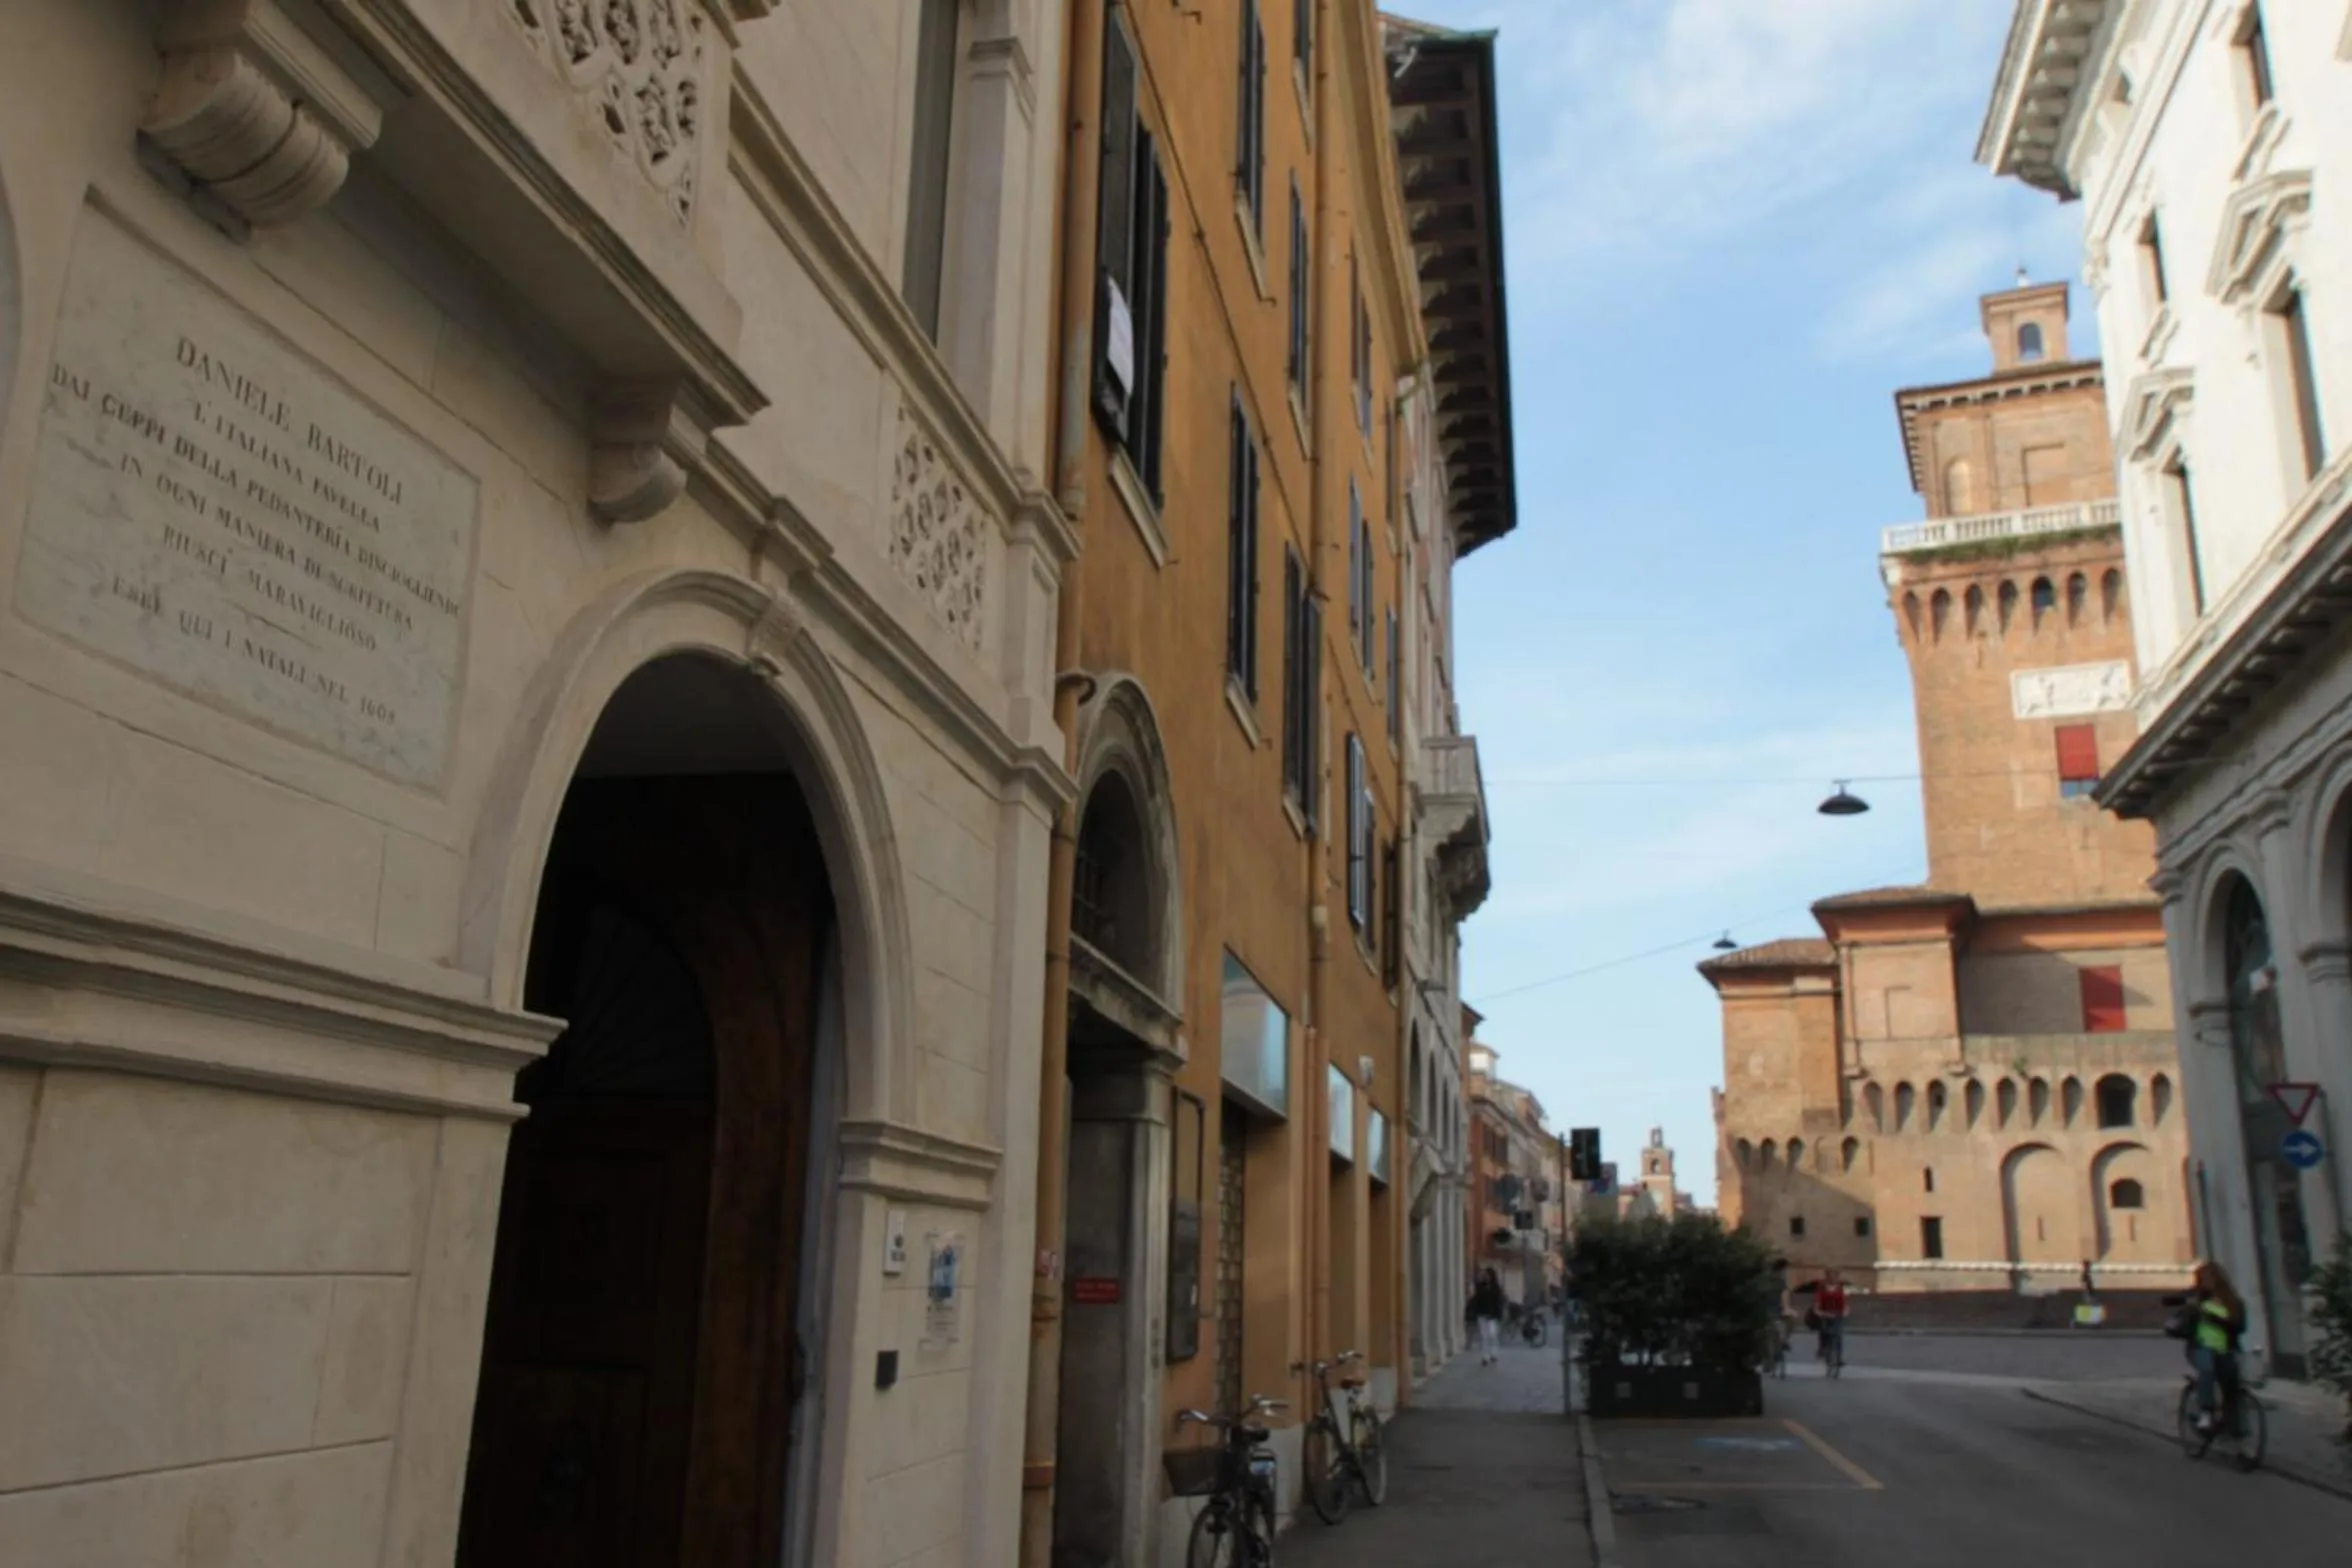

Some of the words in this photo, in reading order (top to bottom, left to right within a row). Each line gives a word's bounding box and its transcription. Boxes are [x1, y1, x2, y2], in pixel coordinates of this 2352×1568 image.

[175, 434, 237, 488] DELLA
[177, 335, 289, 432] DANIELE
[308, 422, 401, 505] BARTOLI
[121, 453, 142, 478] IN
[157, 472, 206, 516] OGNI
[217, 507, 296, 565] MANIERA
[304, 557, 321, 579] DI
